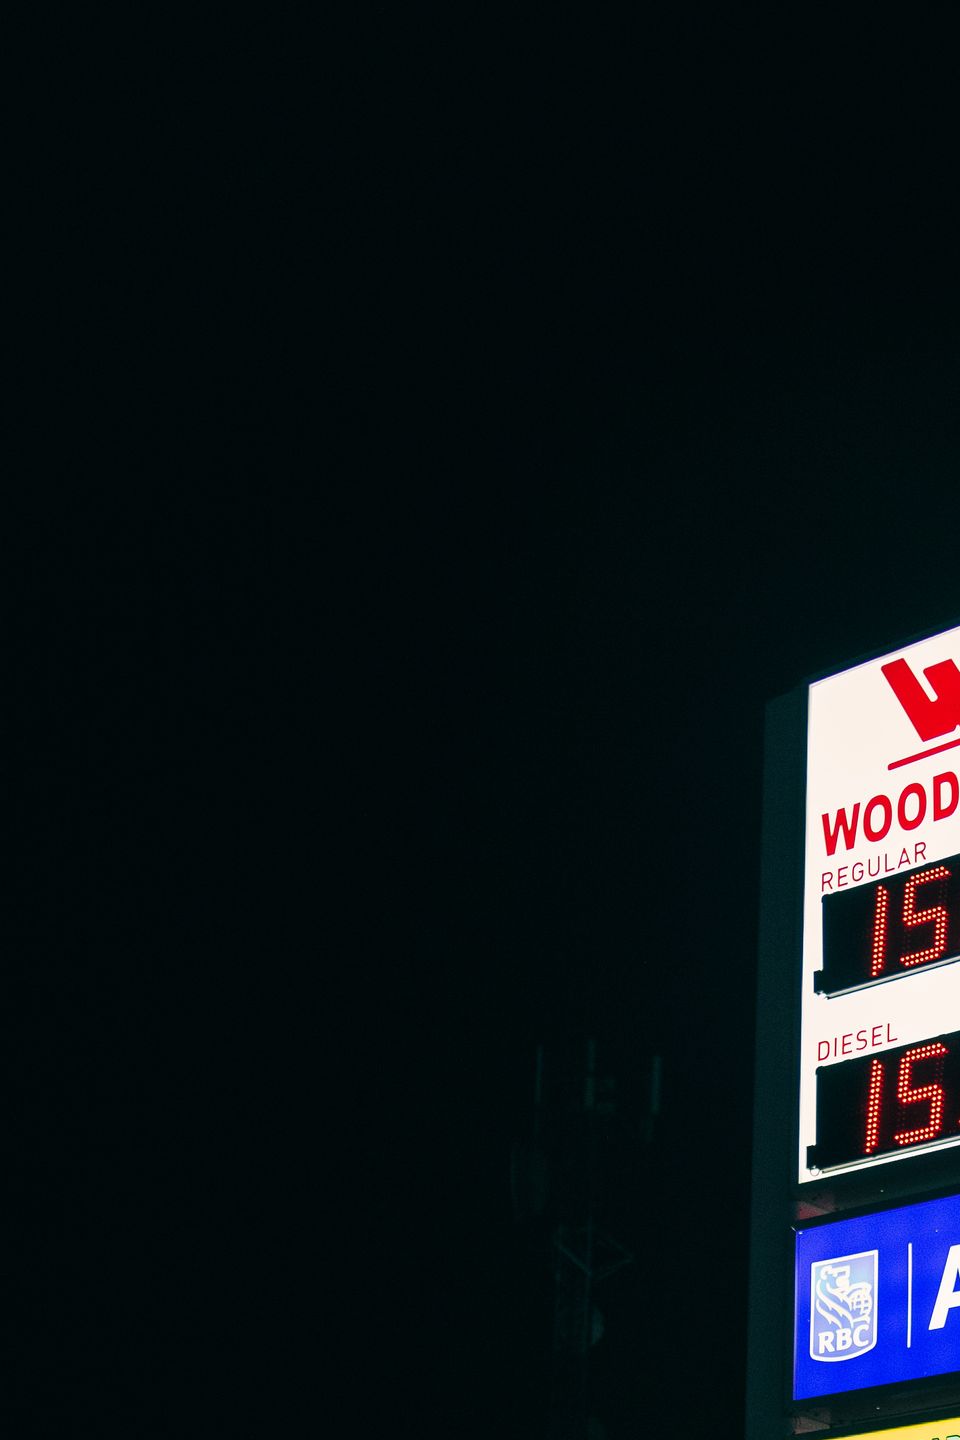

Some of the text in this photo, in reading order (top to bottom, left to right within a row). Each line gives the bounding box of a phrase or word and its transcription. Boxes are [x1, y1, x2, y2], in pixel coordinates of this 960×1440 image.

[821, 841, 928, 893] REGULAR
[817, 1023, 898, 1062] DIESEL
[818, 1324, 869, 1354] RBC
